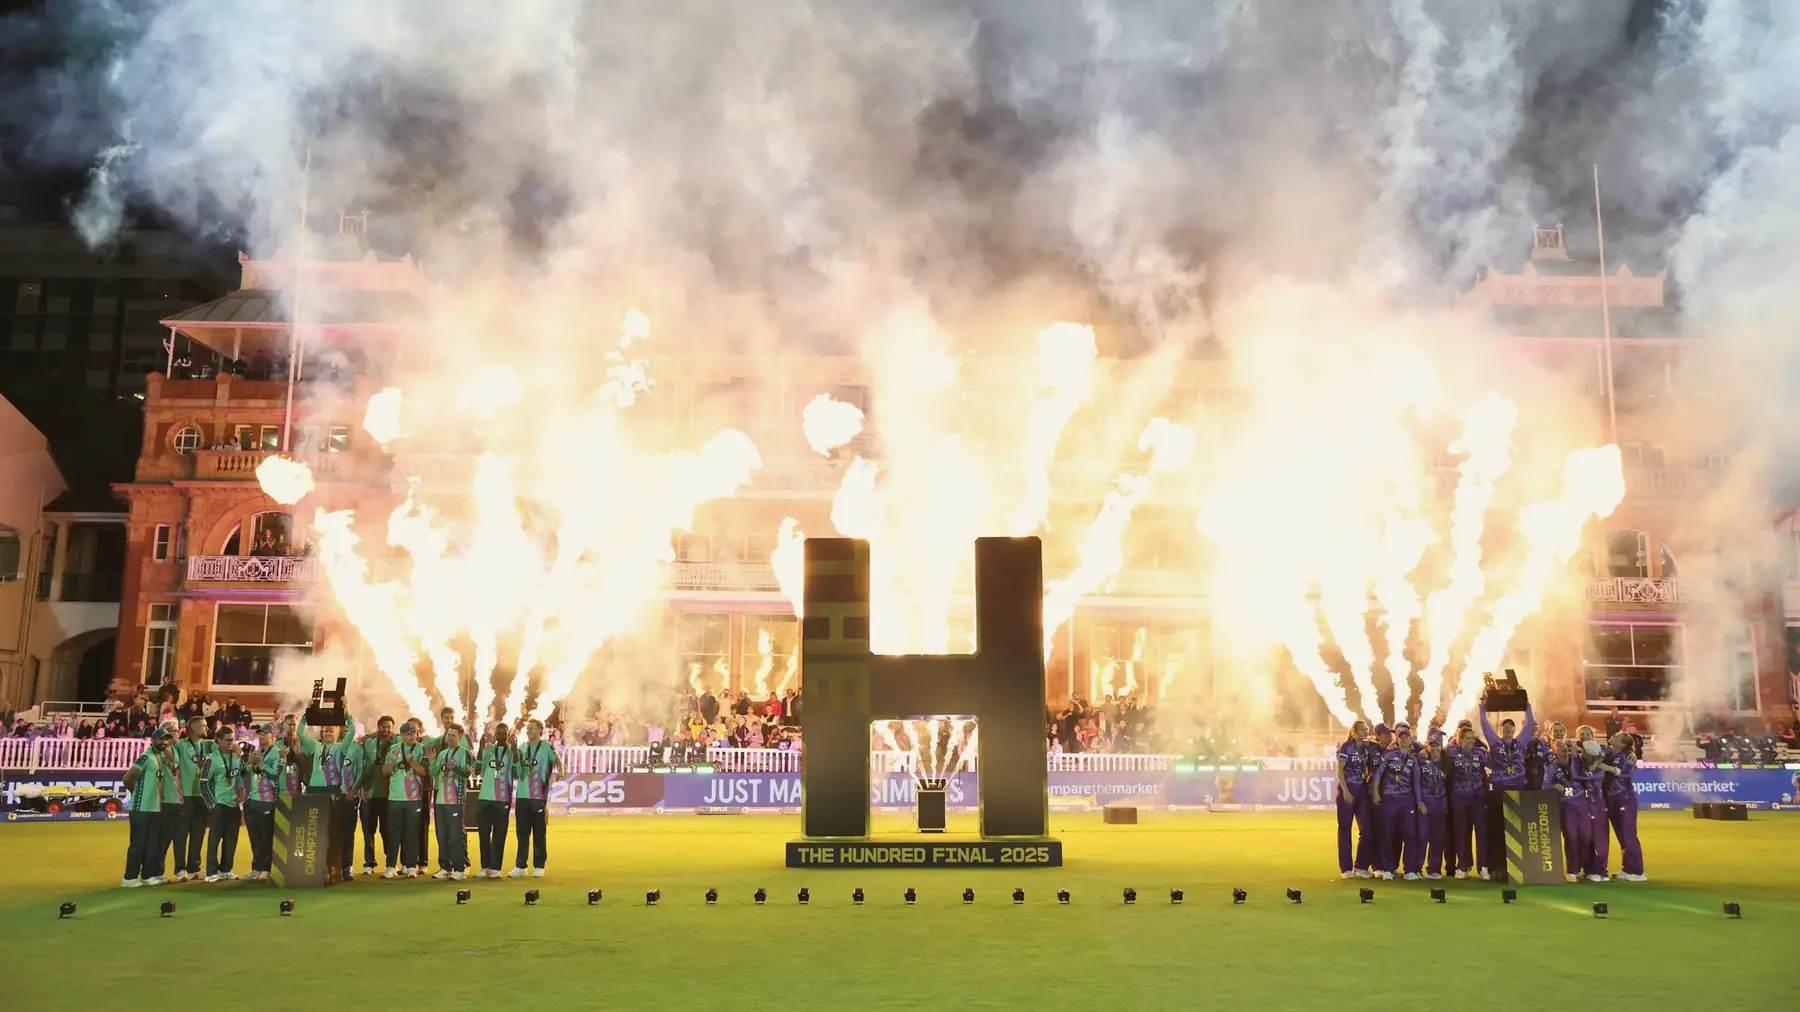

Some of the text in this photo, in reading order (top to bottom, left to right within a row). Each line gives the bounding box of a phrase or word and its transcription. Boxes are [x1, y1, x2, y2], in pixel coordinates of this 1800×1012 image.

[550, 780, 625, 803] 2025
[704, 779, 762, 803] JUST
[871, 779, 964, 803] SIMS
[1046, 783, 1159, 796] mparethemarket
[1277, 776, 1335, 802] JUST
[1631, 780, 1736, 794] parethemarket
[305, 807, 318, 876] CHAMPIONS
[1528, 822, 1539, 853] 2025
[1538, 803, 1553, 872] CHAMPIONS
[798, 847, 1049, 863] THE HUNDRED FINAL 2025
